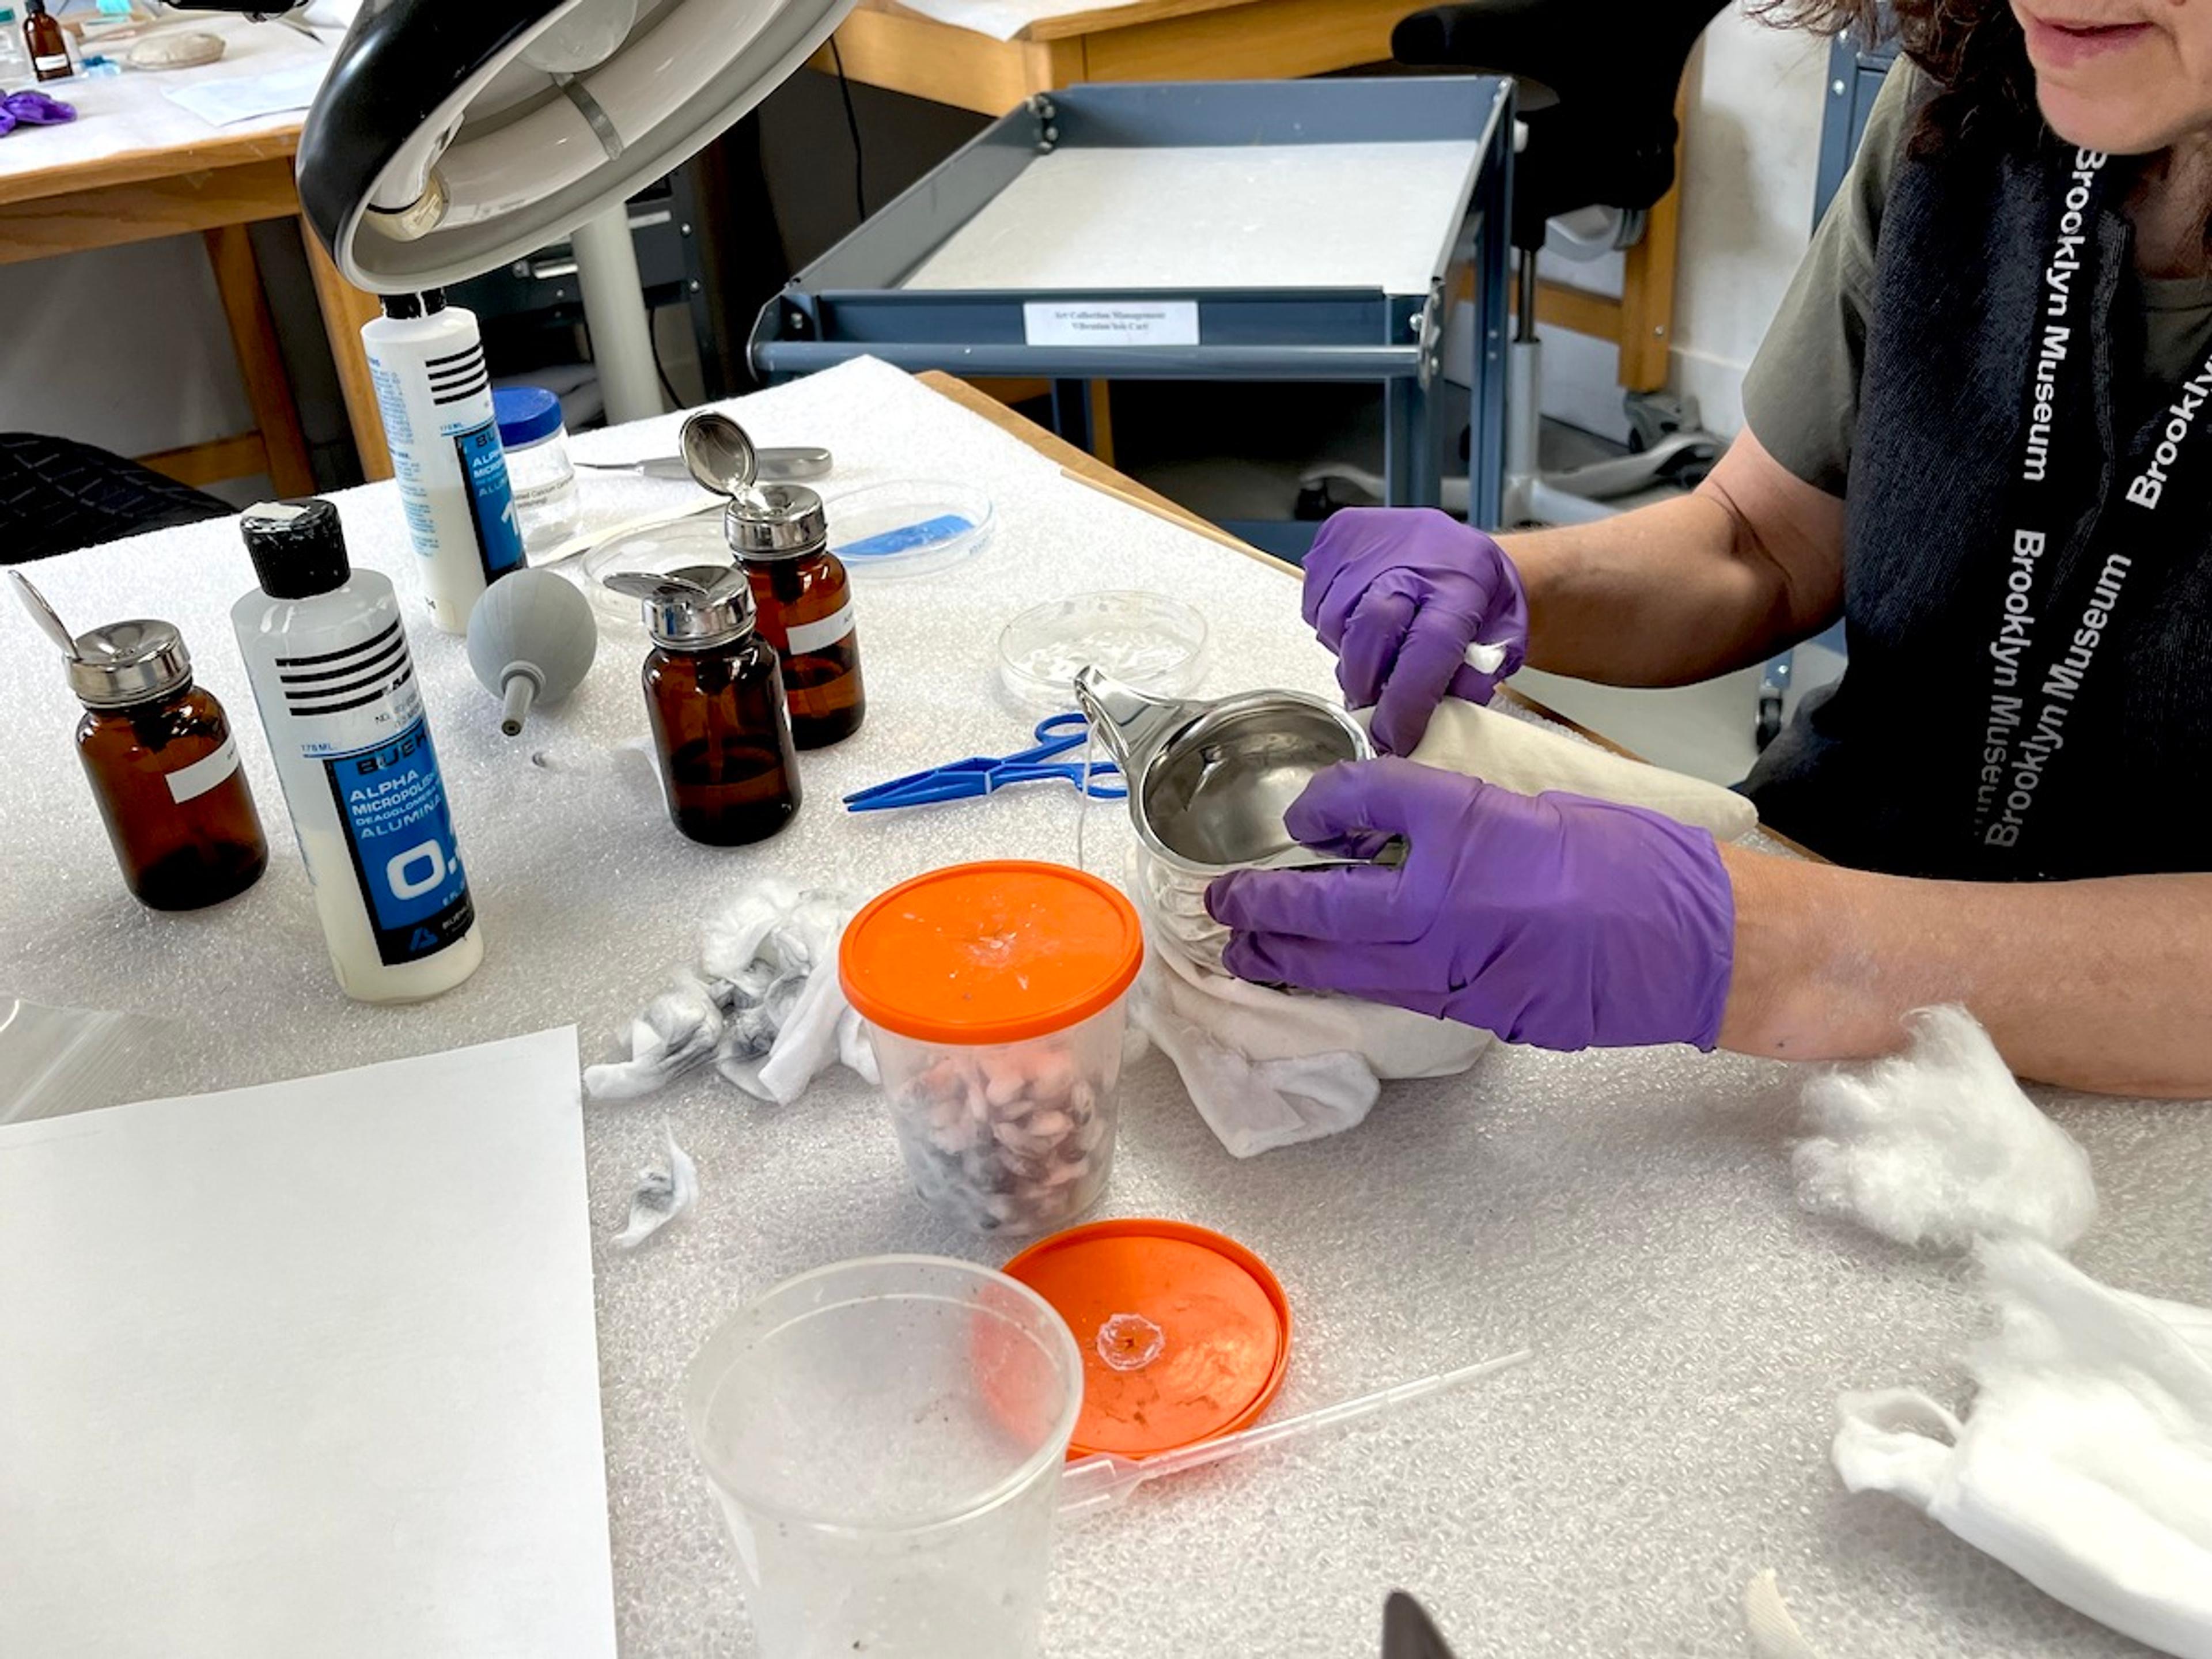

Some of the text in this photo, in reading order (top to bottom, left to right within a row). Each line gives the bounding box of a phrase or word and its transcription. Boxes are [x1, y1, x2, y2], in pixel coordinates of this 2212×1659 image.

[2023, 147, 2108, 482] Brooklyn Museum
[2125, 354, 2212, 510] Brookly
[1990, 529, 2045, 687] Brooklyn
[1984, 554, 2131, 847] Brooklyn Museum
[350, 770, 418, 802] ALPHA
